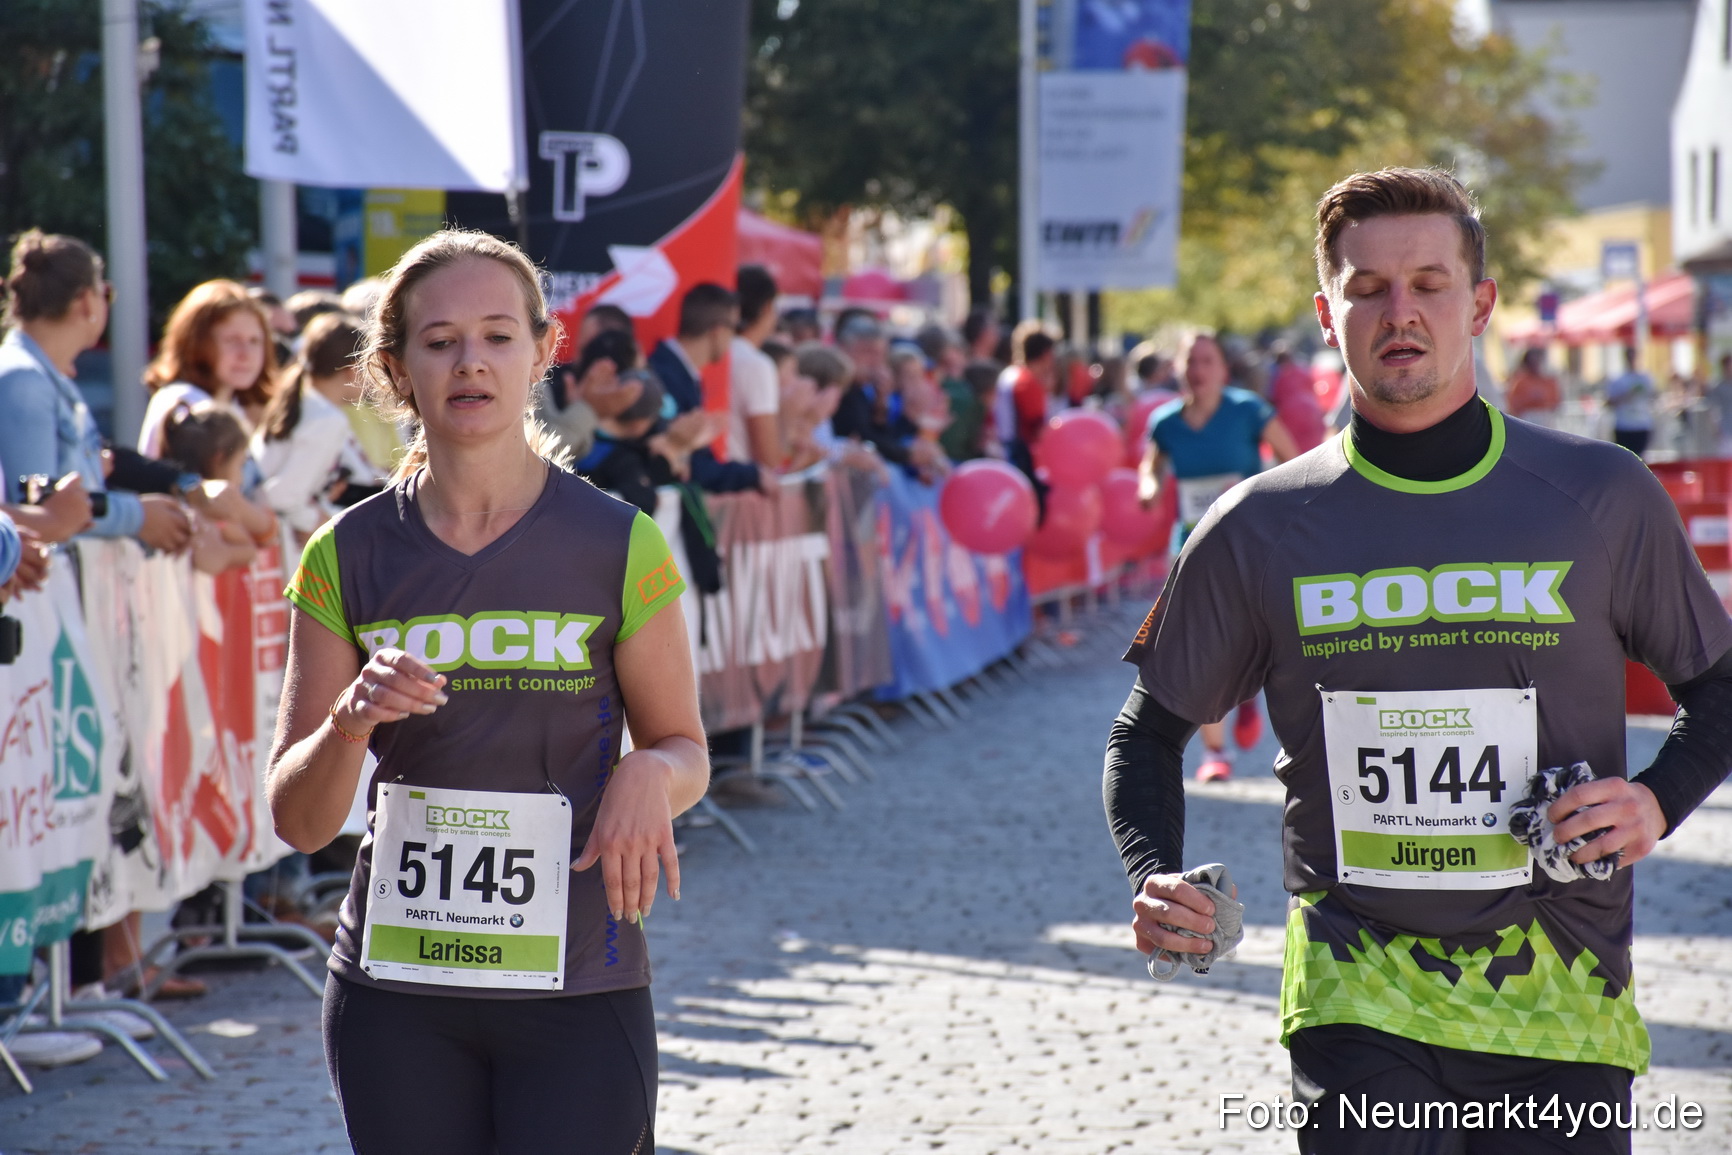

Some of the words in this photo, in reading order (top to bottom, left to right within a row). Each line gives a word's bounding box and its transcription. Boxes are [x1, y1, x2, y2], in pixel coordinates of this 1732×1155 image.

[1292, 561, 1576, 637] BOCK
[1302, 633, 1373, 660] inspired
[1378, 631, 1404, 653] by
[1409, 629, 1469, 647] smart
[1474, 628, 1560, 651] concepts
[451, 674, 512, 692] smart
[518, 675, 596, 694] concepts
[1379, 707, 1473, 730] BOCK
[1380, 730, 1408, 738] inspired
[1409, 730, 1418, 738] by
[1419, 730, 1441, 738] smart
[1442, 729, 1475, 737] concepts
[1357, 744, 1507, 805] 5144
[426, 805, 511, 831] BOCK
[1373, 813, 1413, 827] PARTL
[1415, 815, 1477, 827] Neumarkt
[425, 826, 449, 835] inspired
[450, 828, 459, 836] by
[460, 829, 479, 837] smart
[480, 830, 511, 838] concepts
[1391, 841, 1476, 872] Jürgen
[397, 840, 536, 905] 5145
[405, 908, 444, 922] PARTL
[446, 911, 505, 926] Neumarkt
[419, 935, 503, 965] Larissa
